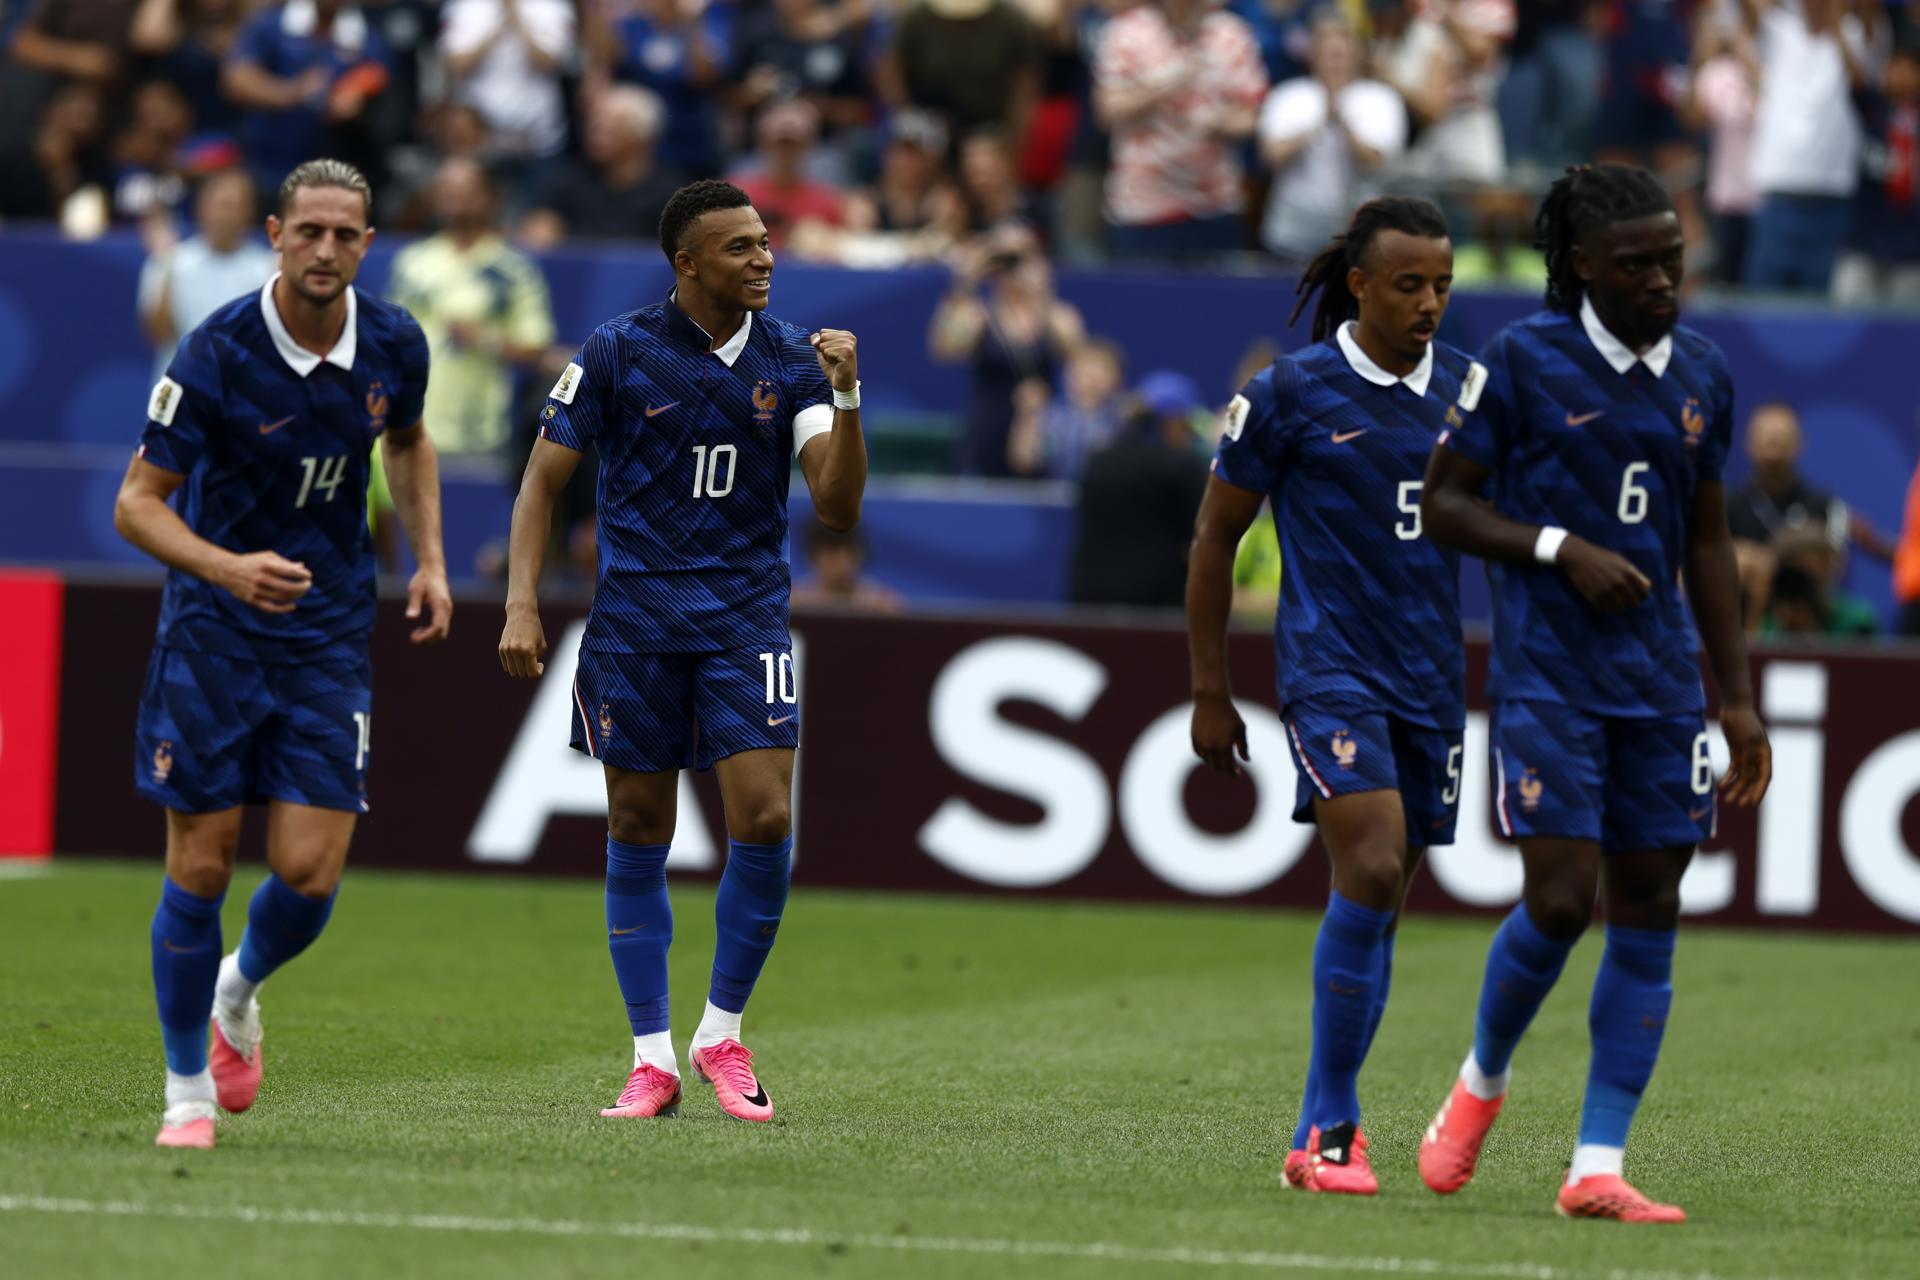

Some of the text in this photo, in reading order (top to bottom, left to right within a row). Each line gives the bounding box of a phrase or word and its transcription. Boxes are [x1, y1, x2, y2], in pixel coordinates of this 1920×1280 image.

[295, 455, 348, 508] 14
[692, 444, 738, 499] 10
[1617, 461, 1650, 524] 6
[1395, 480, 1424, 541] 5
[759, 652, 798, 704] 10
[1441, 744, 1463, 805] 5
[1691, 732, 1713, 796] 6
